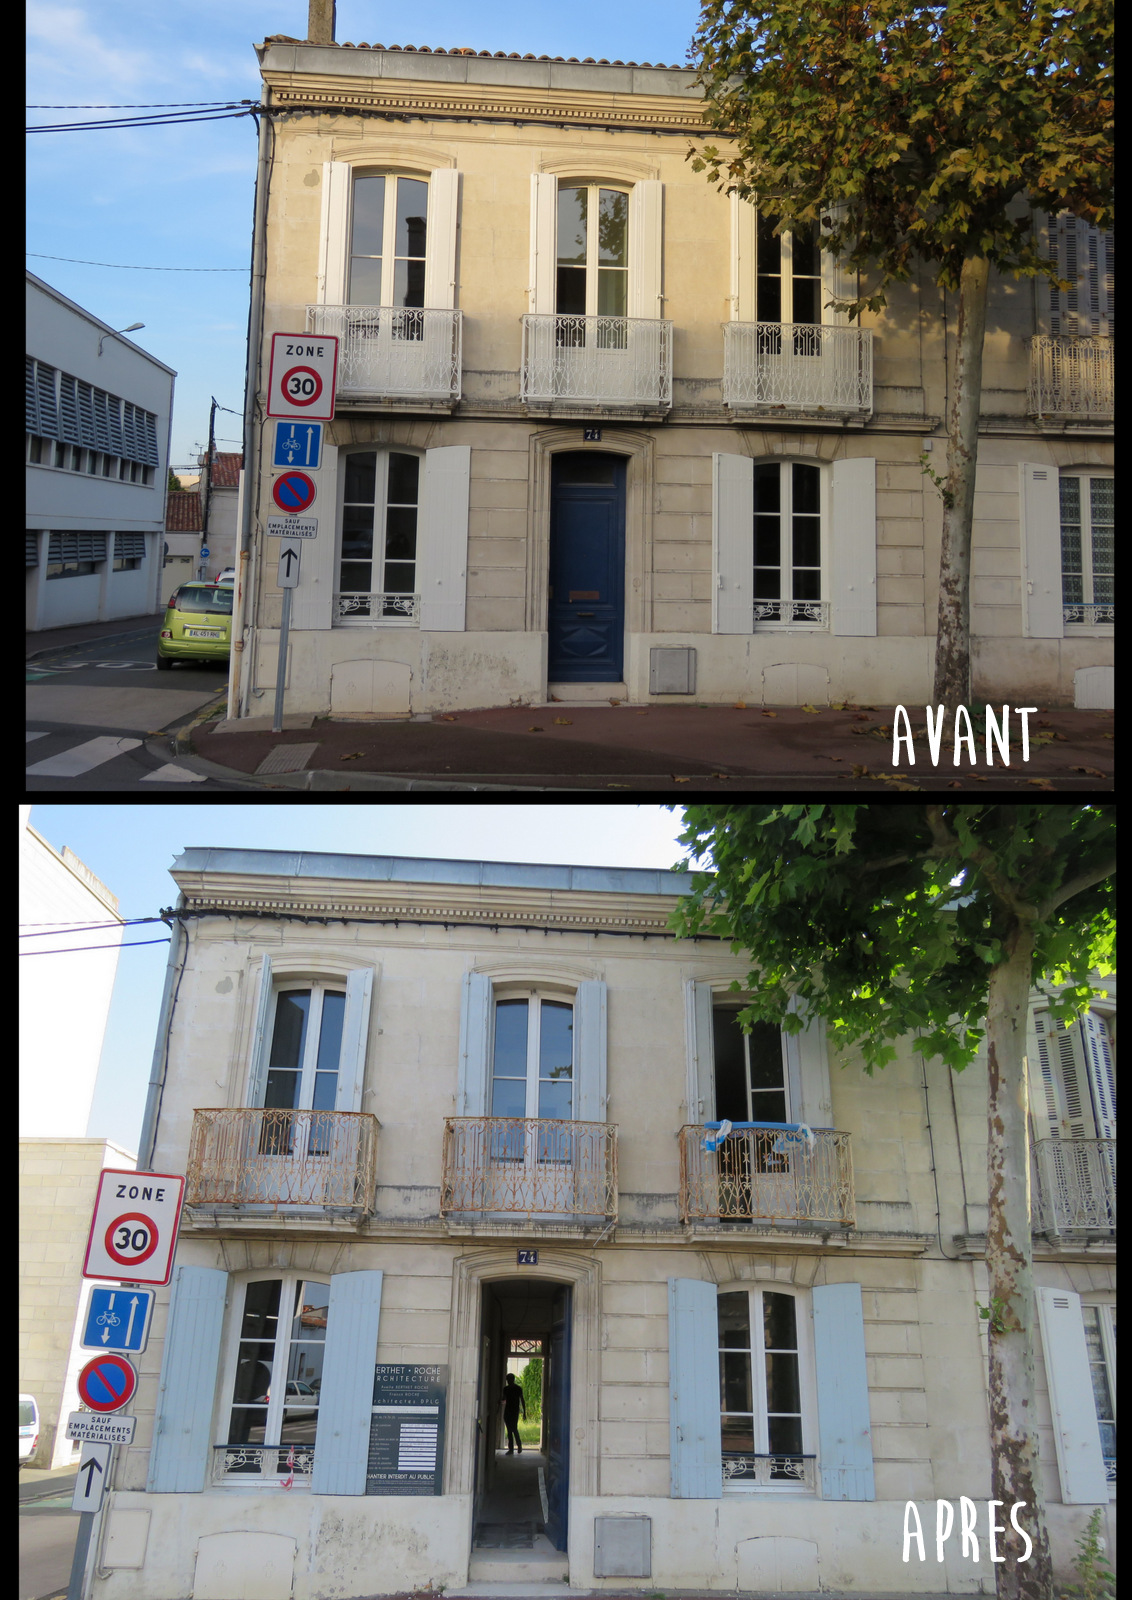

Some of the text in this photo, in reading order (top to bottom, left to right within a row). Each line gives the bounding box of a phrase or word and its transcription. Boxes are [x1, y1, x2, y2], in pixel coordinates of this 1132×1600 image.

[286, 344, 324, 358] ZONE
[289, 377, 315, 396] 30
[268, 523, 315, 531] EMPLACEMENTS
[270, 529, 313, 537] MATÉRIALISÉS
[116, 1184, 166, 1202] ZONE
[115, 1227, 149, 1251] 30
[519, 1251, 536, 1263] 74
[376, 1366, 441, 1375] ERTHET ROCHE
[376, 1375, 441, 1383] RCHITECTURE
[91, 1416, 112, 1424] SAUF
[68, 1422, 131, 1434] EMPLACEMENTS
[70, 1430, 126, 1442] MATÉRIALISÉS
